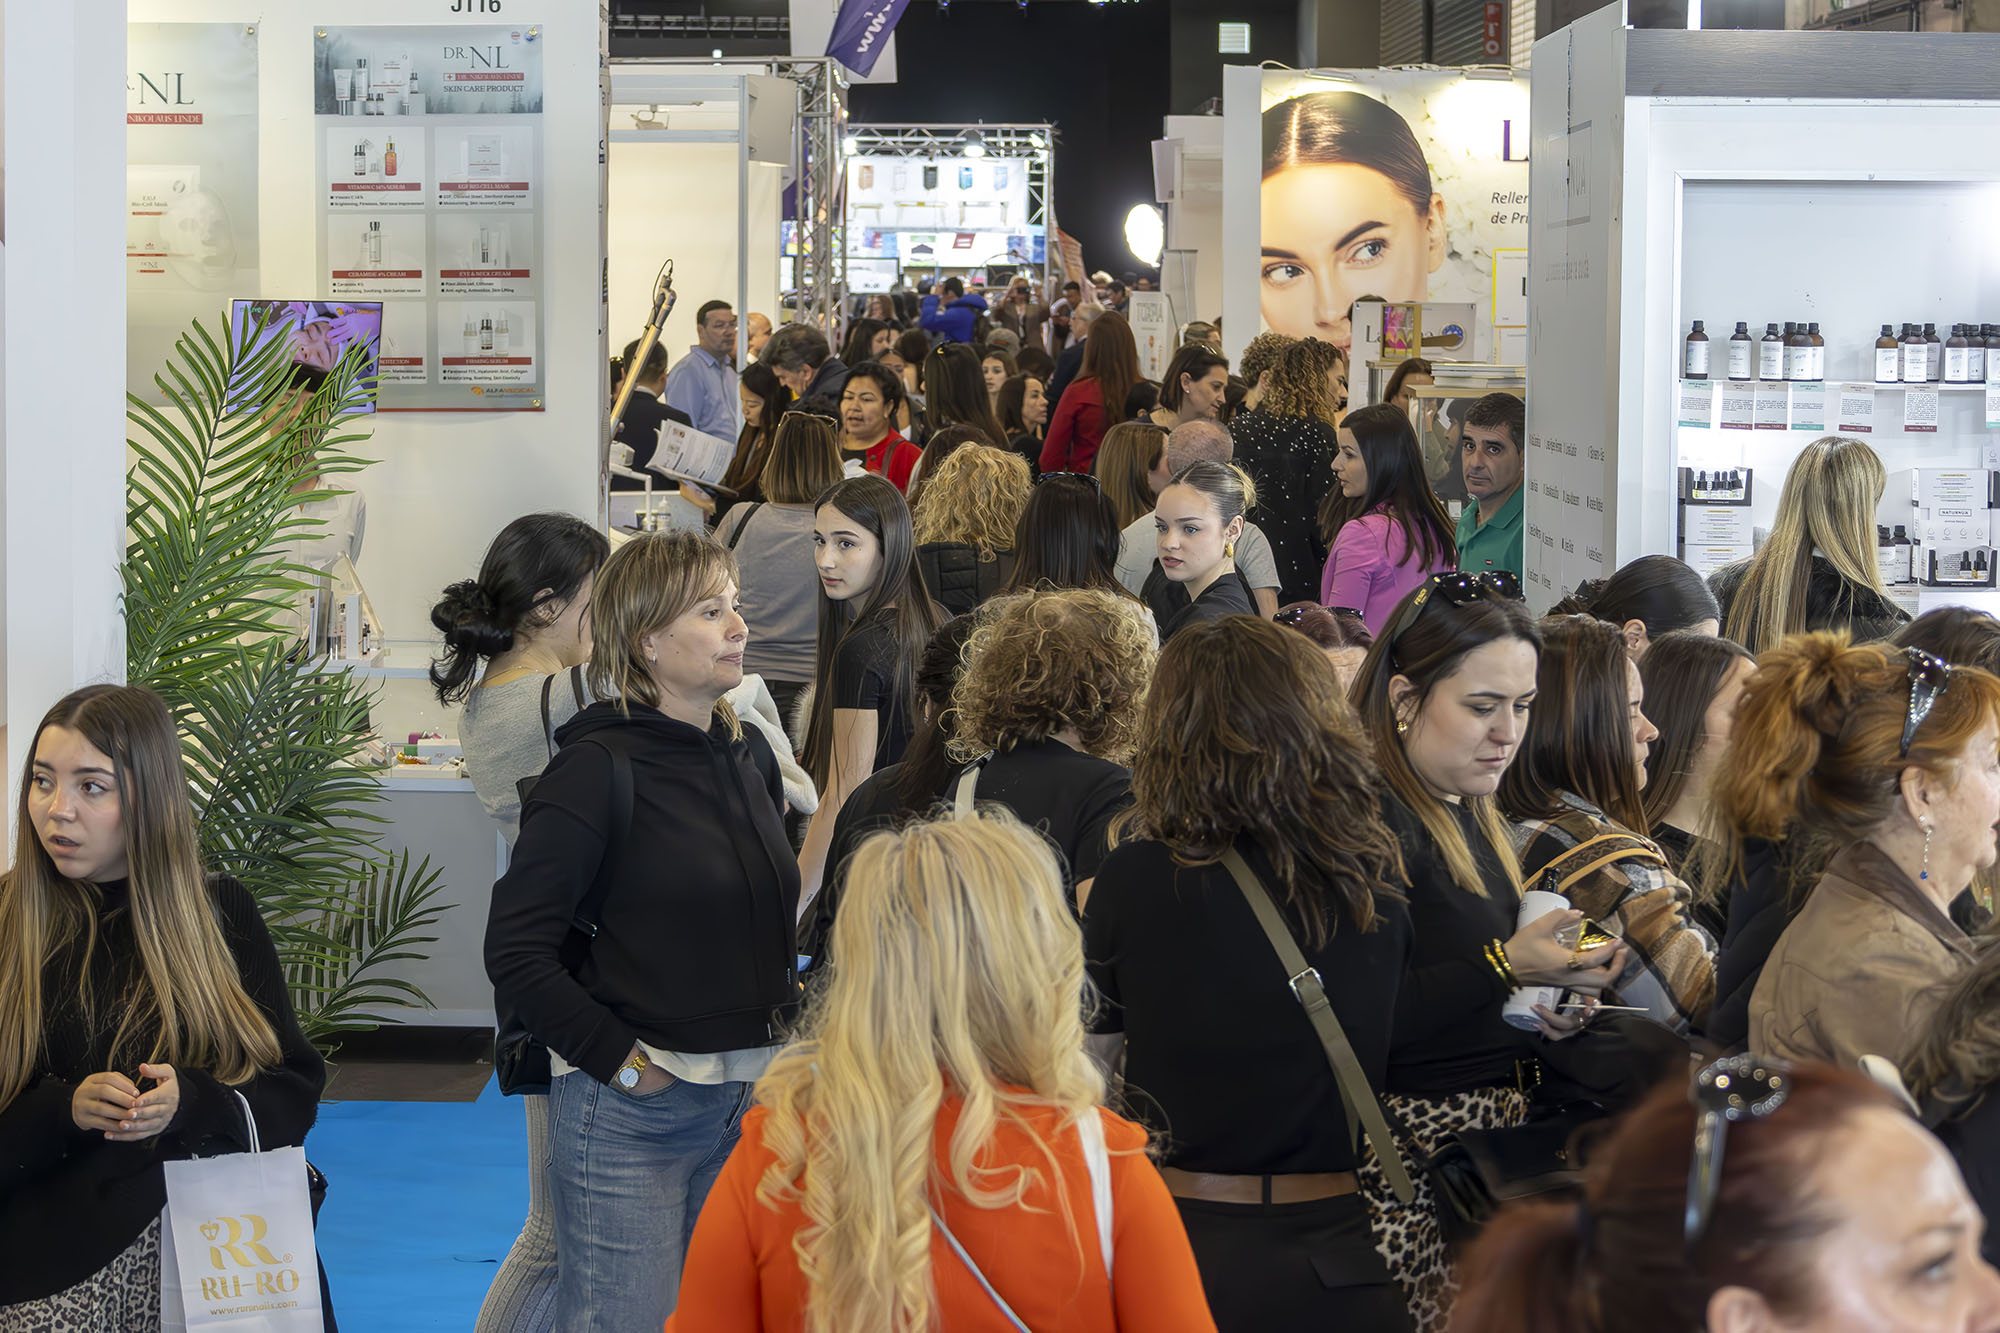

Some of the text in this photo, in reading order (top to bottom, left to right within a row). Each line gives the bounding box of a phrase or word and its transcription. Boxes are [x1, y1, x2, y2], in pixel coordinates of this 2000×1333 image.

[469, 45, 510, 69] NL
[138, 72, 195, 105] NL
[443, 85, 525, 93] SKIN CARE PRODUCT
[128, 113, 201, 124] NIKOLAUS LINDE
[1490, 212, 1508, 225] de
[200, 1268, 300, 1301] RU-RO
